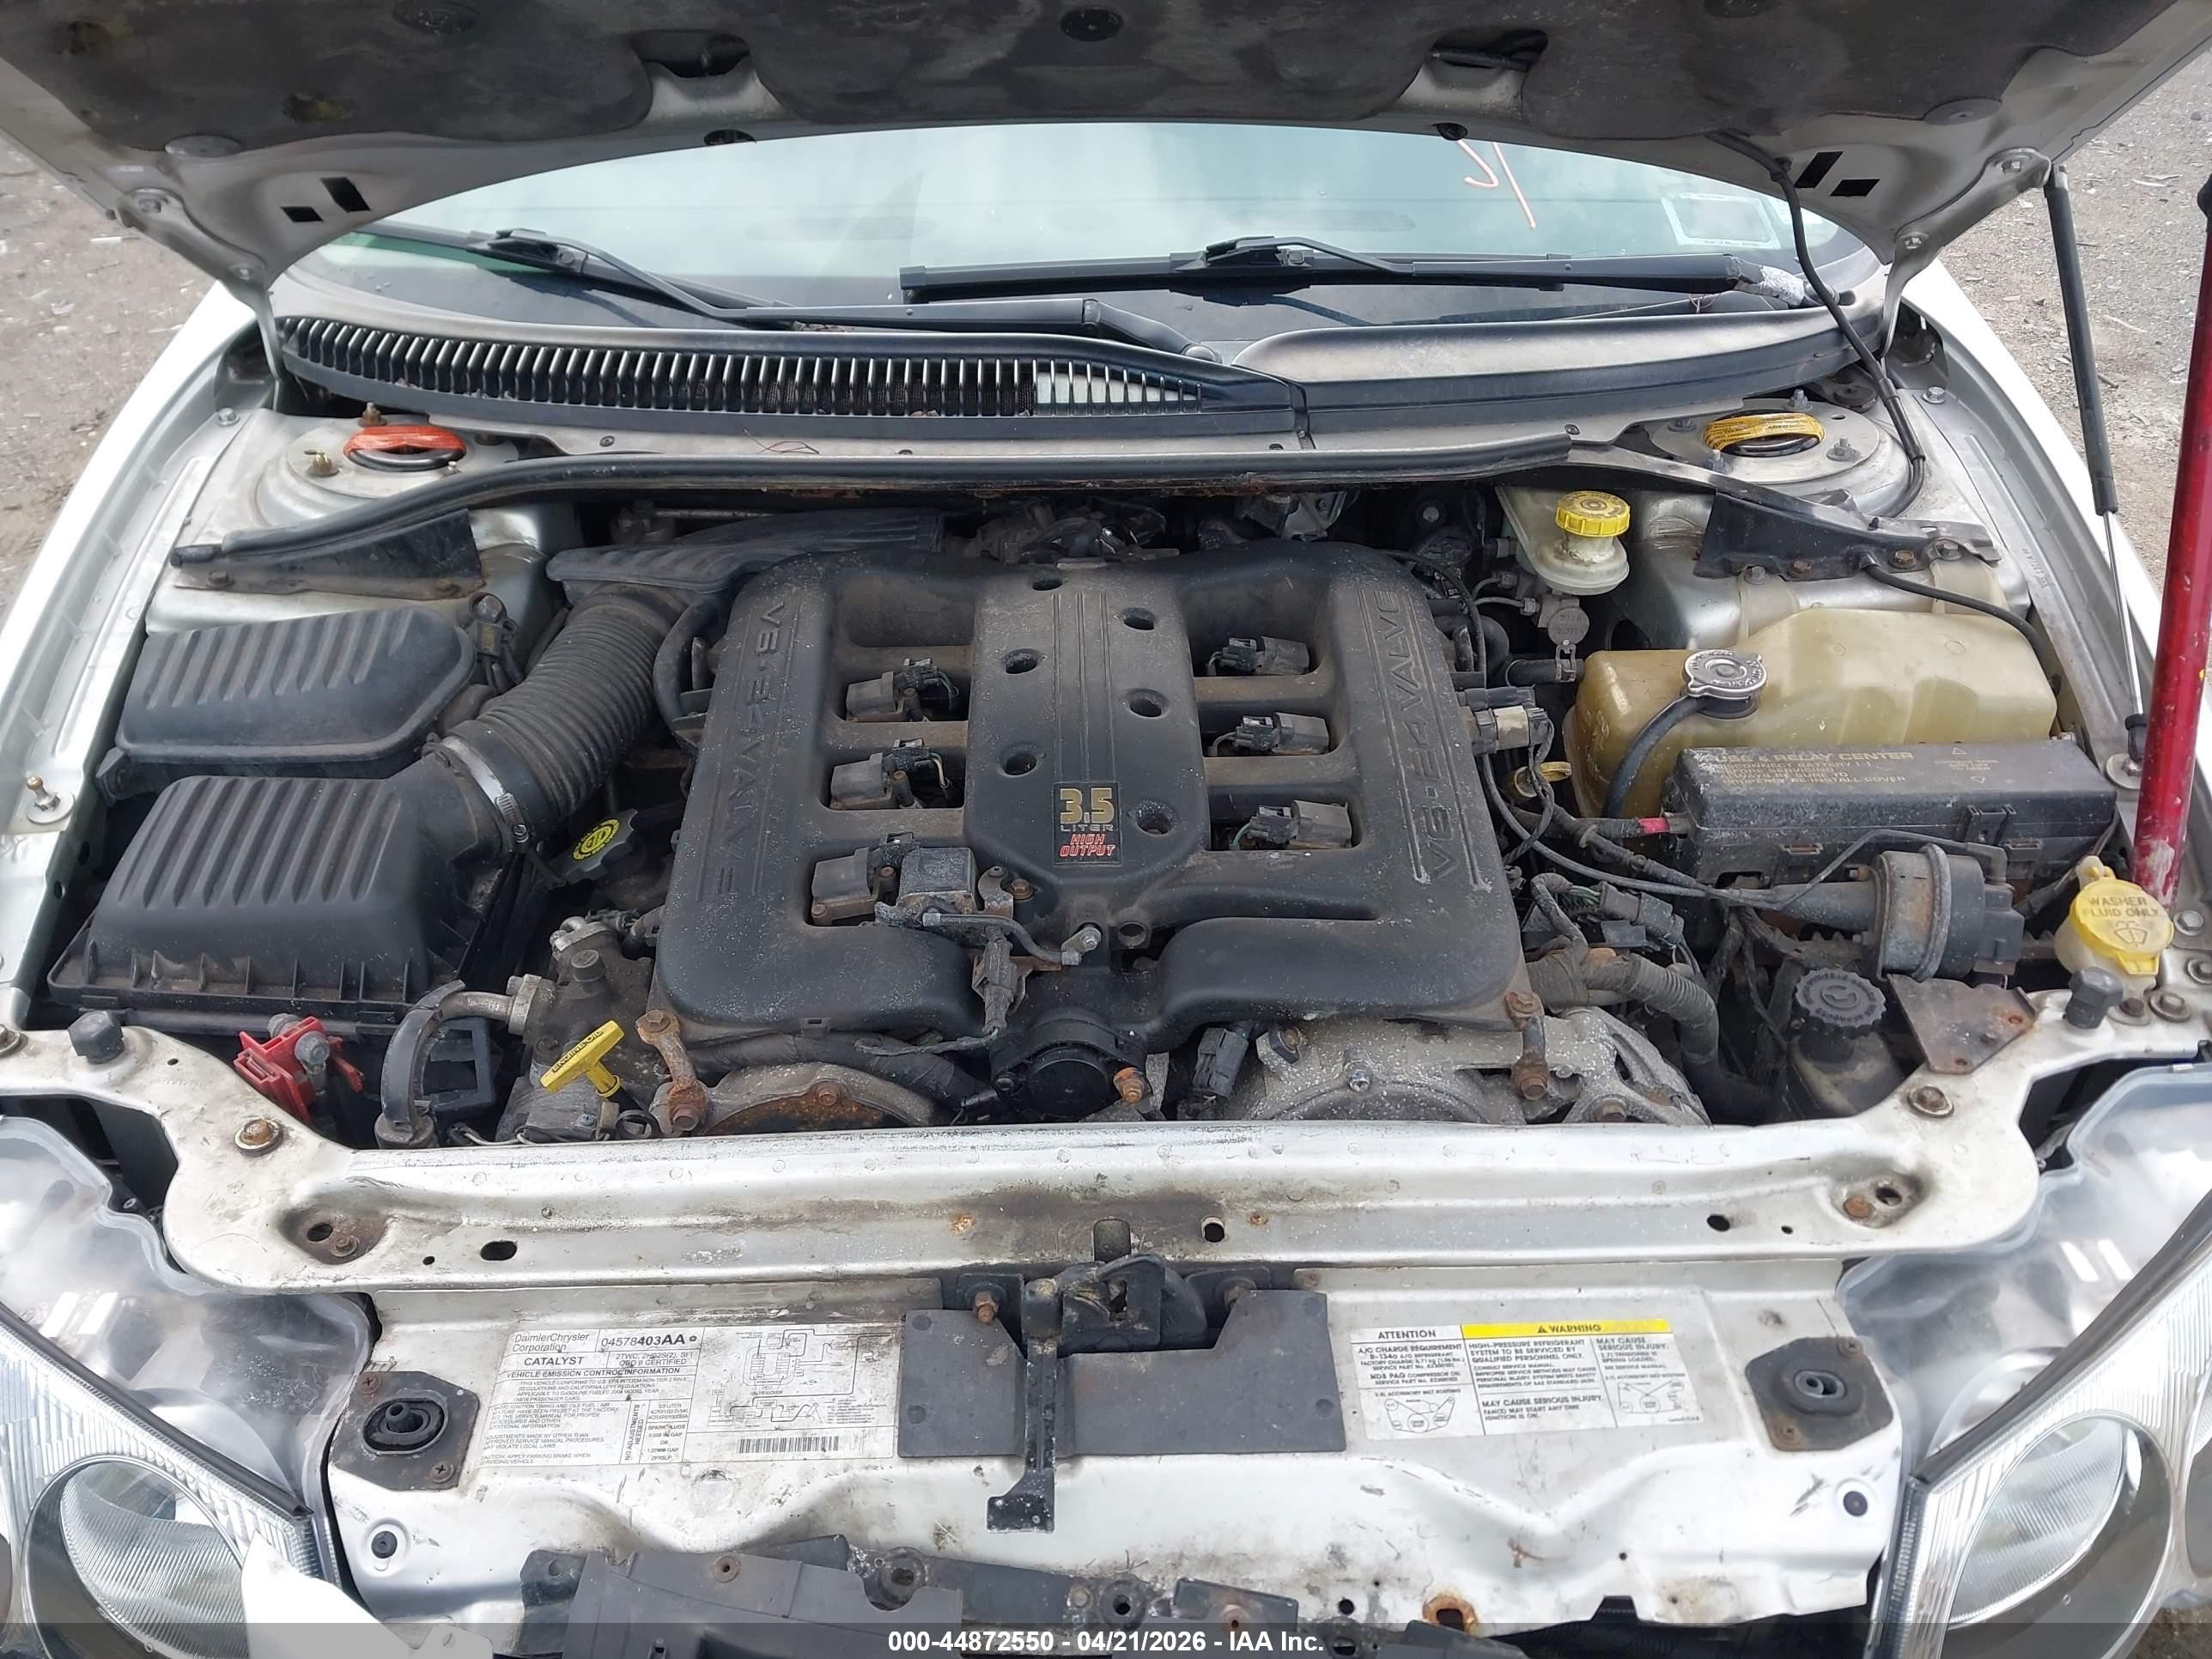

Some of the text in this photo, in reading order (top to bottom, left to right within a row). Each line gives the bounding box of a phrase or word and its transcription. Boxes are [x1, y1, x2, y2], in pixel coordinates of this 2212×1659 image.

[1374, 591, 1422, 711] VALVE
[1060, 787, 1115, 824] 3.5
[1060, 823, 1114, 832] LITER
[1070, 834, 1105, 845] HIGH
[1060, 845, 1116, 857] OUTPUT
[2089, 896, 2148, 906] WASHER
[2083, 907, 2159, 918] FLUID ONLY
[551, 1030, 604, 1073] ENGINE OIL
[1550, 1323, 1601, 1334] WARNING
[514, 1332, 590, 1343] DaimlerChrysler
[1377, 1330, 1437, 1340] ATTENTION
[601, 1334, 686, 1348] 04578403AA
[1533, 1339, 1585, 1347] REFRIGERANT
[512, 1343, 567, 1354] Corporation
[524, 1357, 585, 1366] CATALYST
[542, 1370, 582, 1378] EMISSION
[624, 1367, 681, 1376] INFORMATION
[1482, 1399, 1501, 1407] MAY
[1503, 1398, 1531, 1407] CAUSE
[1533, 1396, 1570, 1405] SERIOUS
[625, 1404, 641, 1461] NO ADJUSTMENTS
